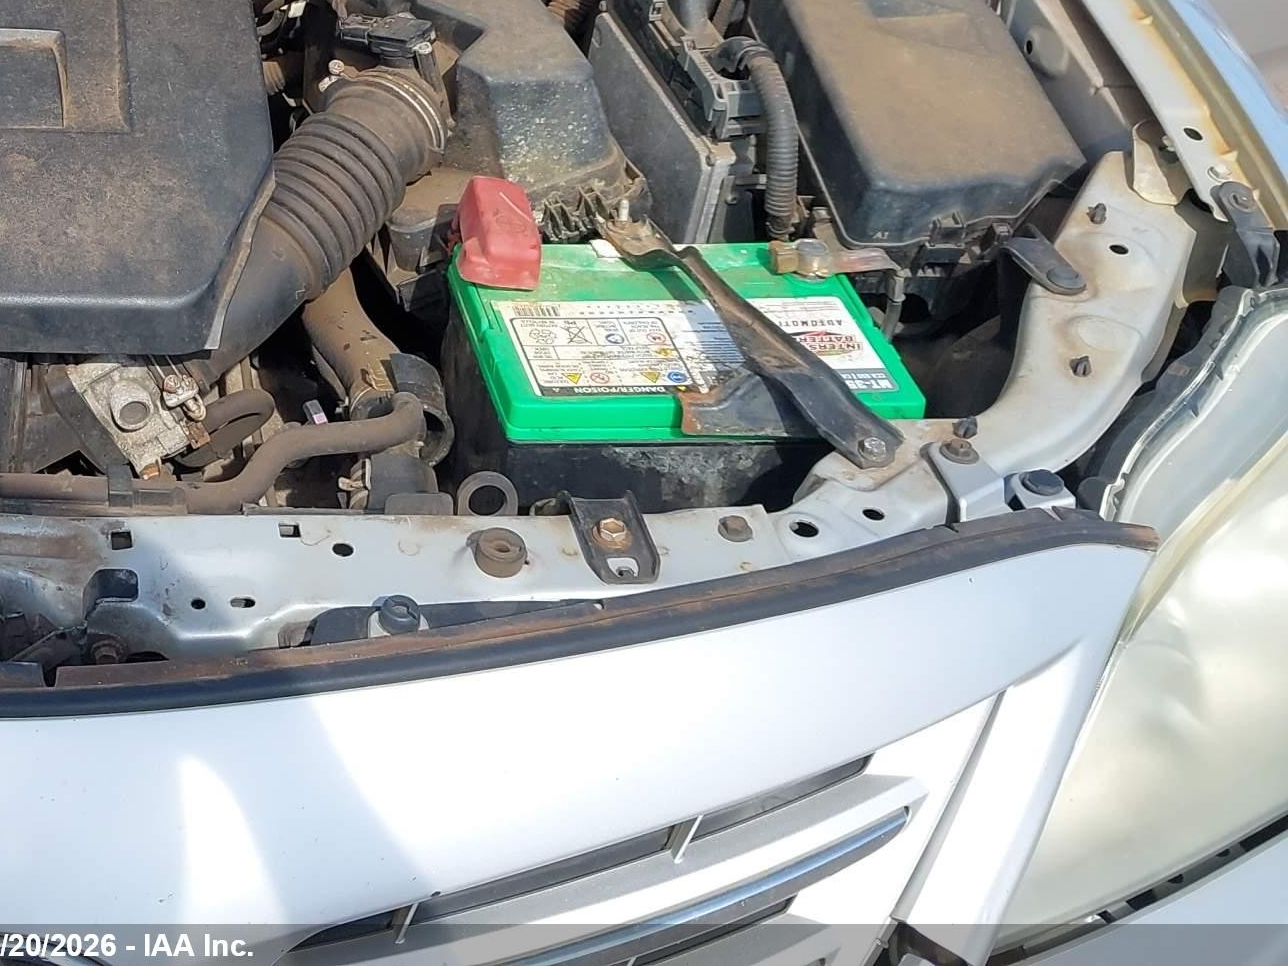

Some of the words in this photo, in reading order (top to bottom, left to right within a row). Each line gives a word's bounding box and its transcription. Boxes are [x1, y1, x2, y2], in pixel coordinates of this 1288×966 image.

[778, 319, 843, 327] AUTOMOTI
[797, 335, 853, 343] BATTER
[808, 343, 861, 351] INTERS
[573, 386, 666, 394] DANGER/POISON
